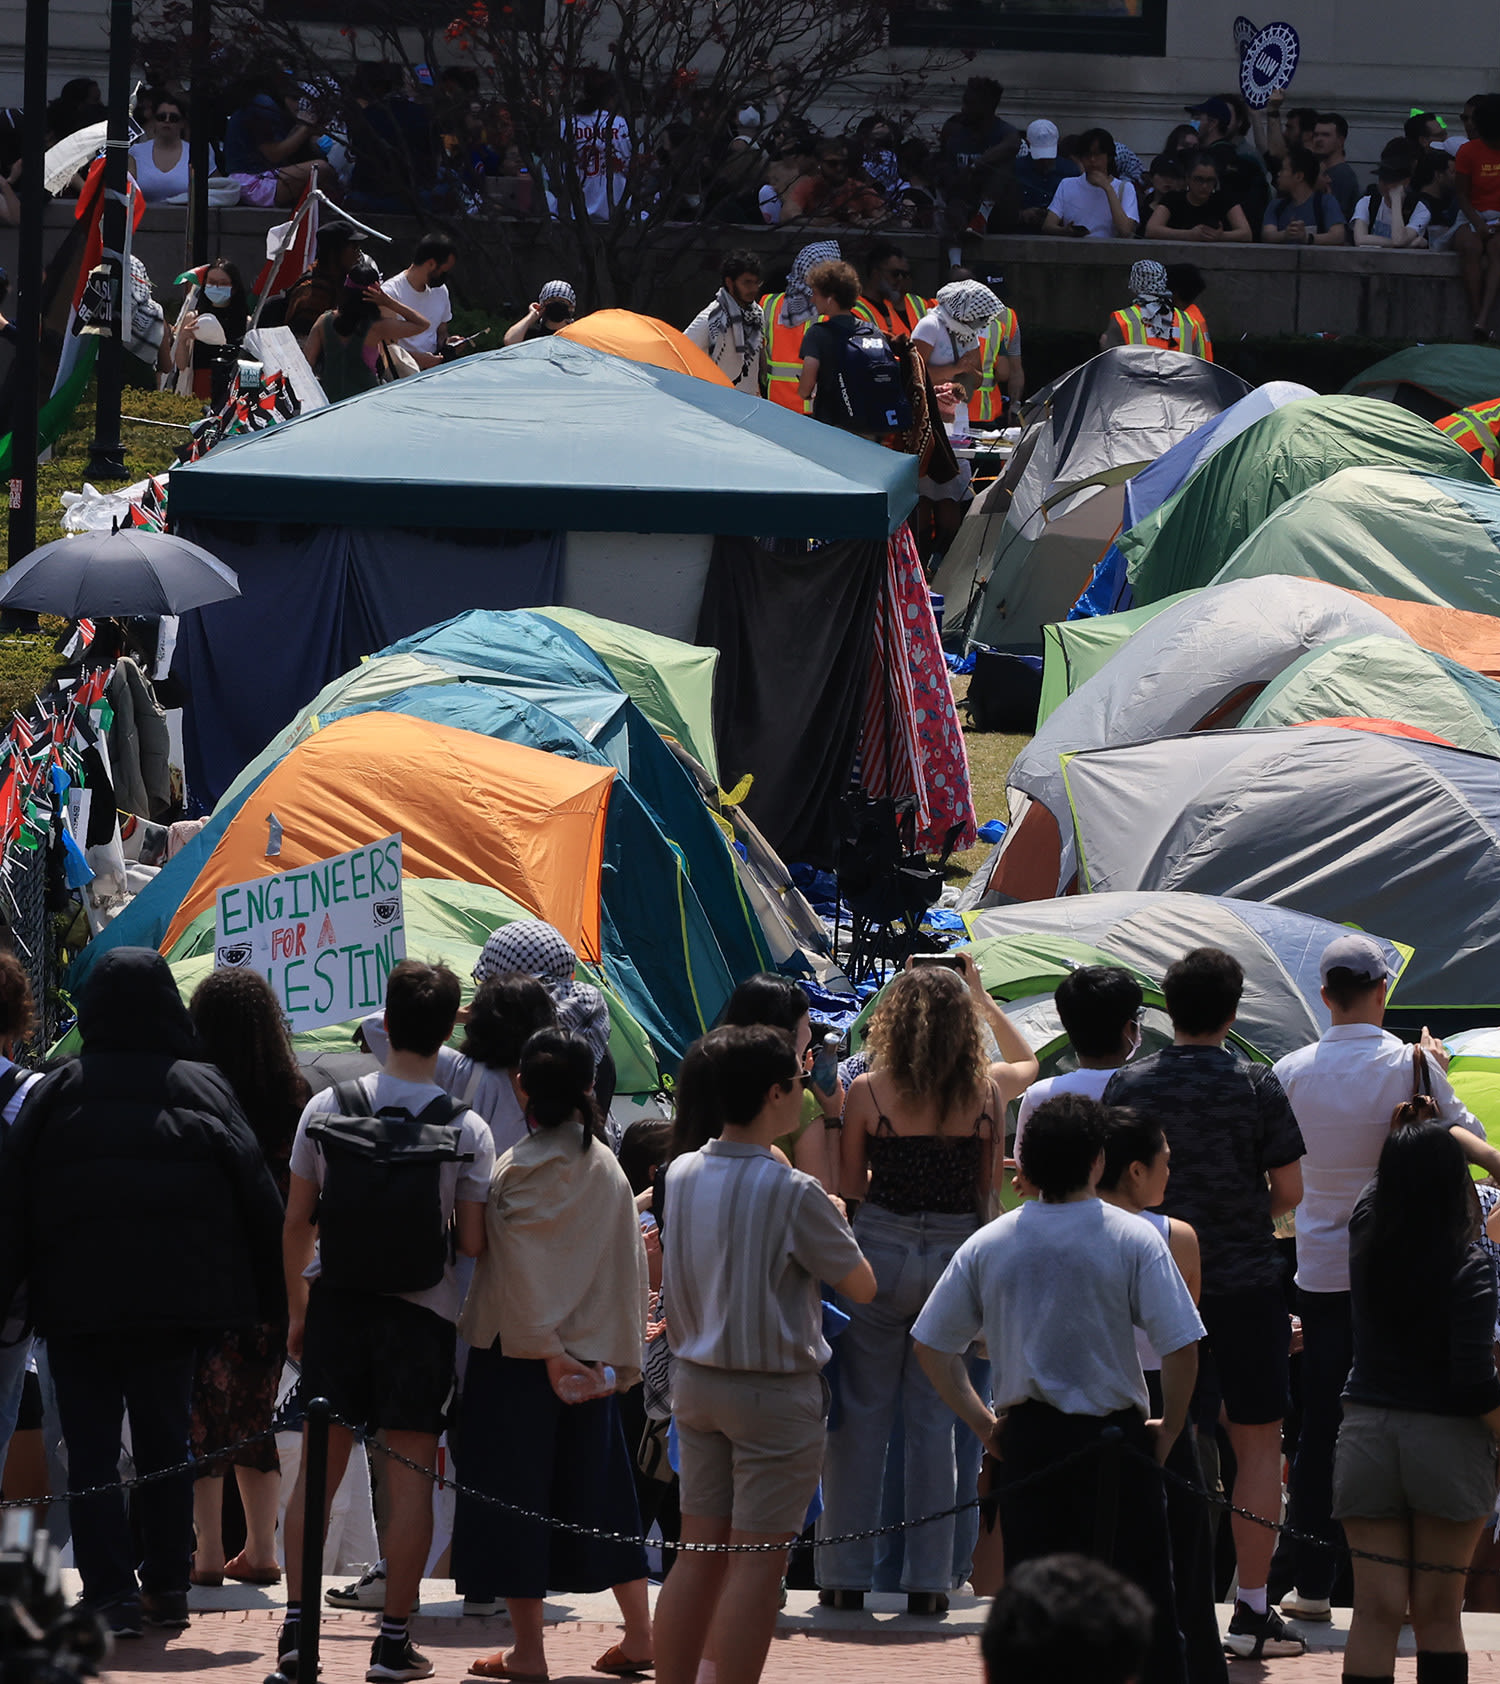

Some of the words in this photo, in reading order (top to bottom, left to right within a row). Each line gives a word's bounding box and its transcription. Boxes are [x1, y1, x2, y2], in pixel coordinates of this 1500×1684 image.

[1255, 51, 1279, 77] UAW
[841, 388, 854, 417] balance
[221, 841, 399, 936] ENGINEERS
[271, 922, 307, 961] FOR
[316, 912, 337, 949] A
[267, 926, 403, 1023] ESTINE
